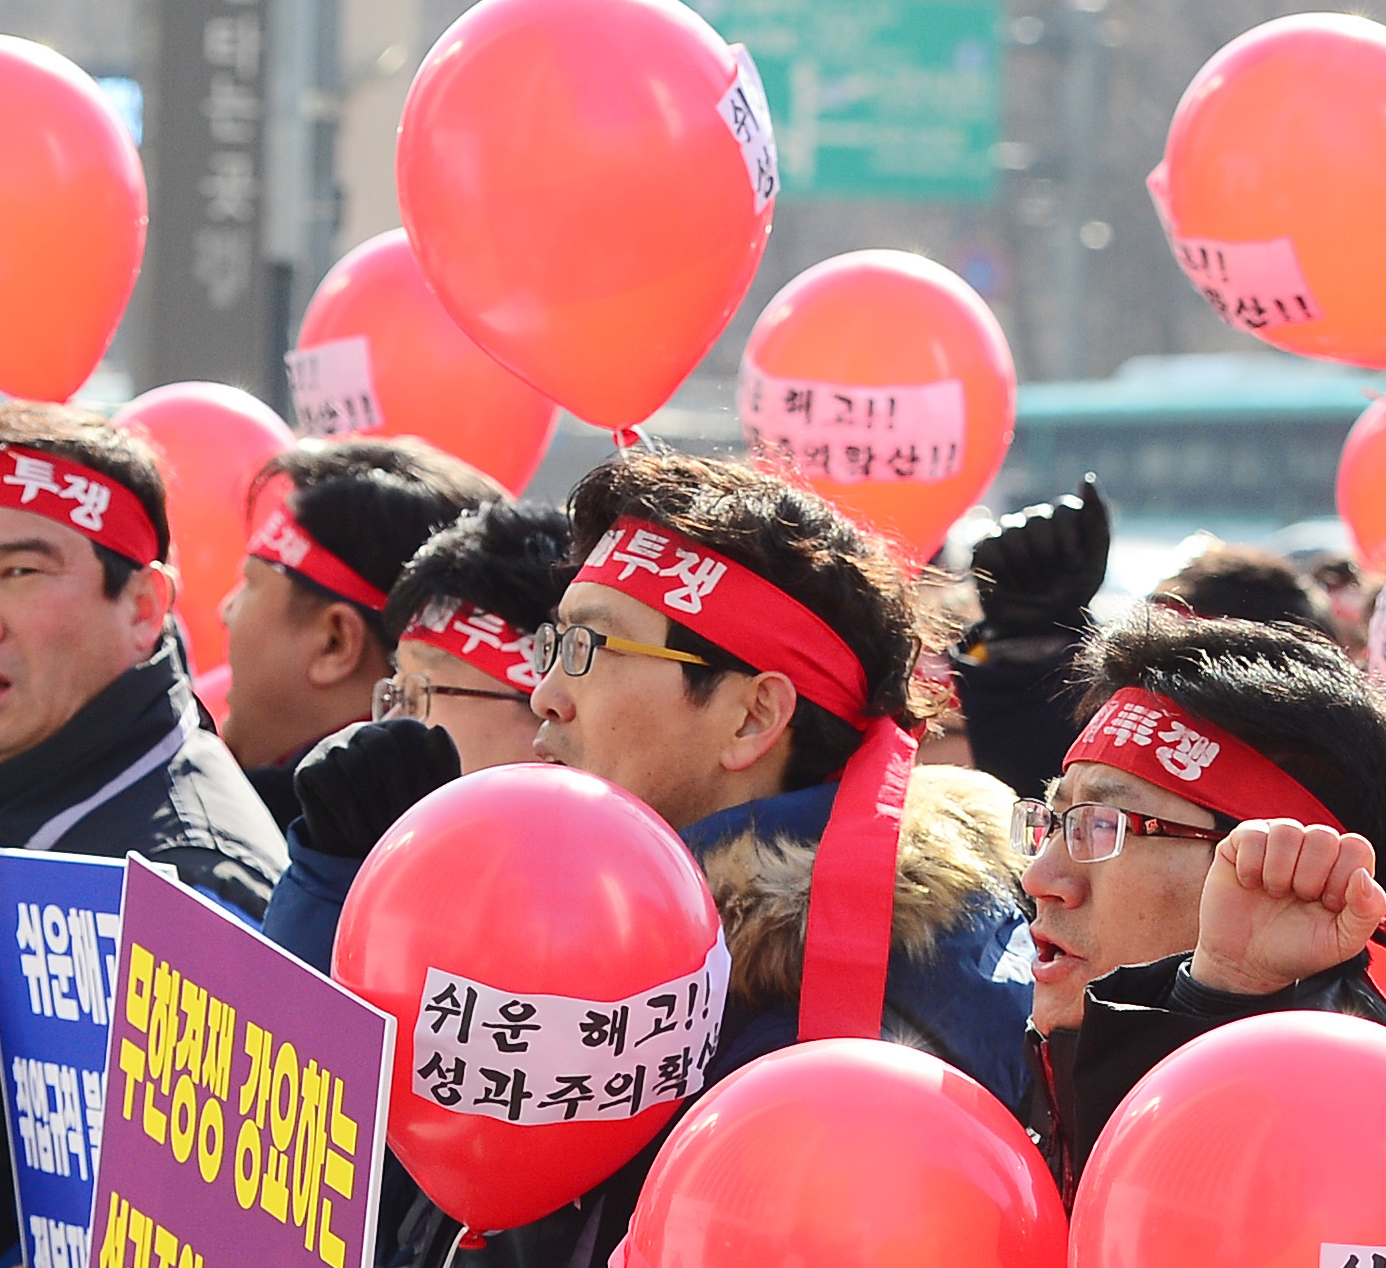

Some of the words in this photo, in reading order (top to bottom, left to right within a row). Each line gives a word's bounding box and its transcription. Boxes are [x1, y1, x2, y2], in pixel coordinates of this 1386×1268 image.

[2, 456, 113, 534] 투쟁
[613, 528, 726, 615] 투쟁
[424, 982, 543, 1053] 쉬운
[578, 970, 711, 1057] 해고!!
[119, 942, 234, 1184] 무한경쟁
